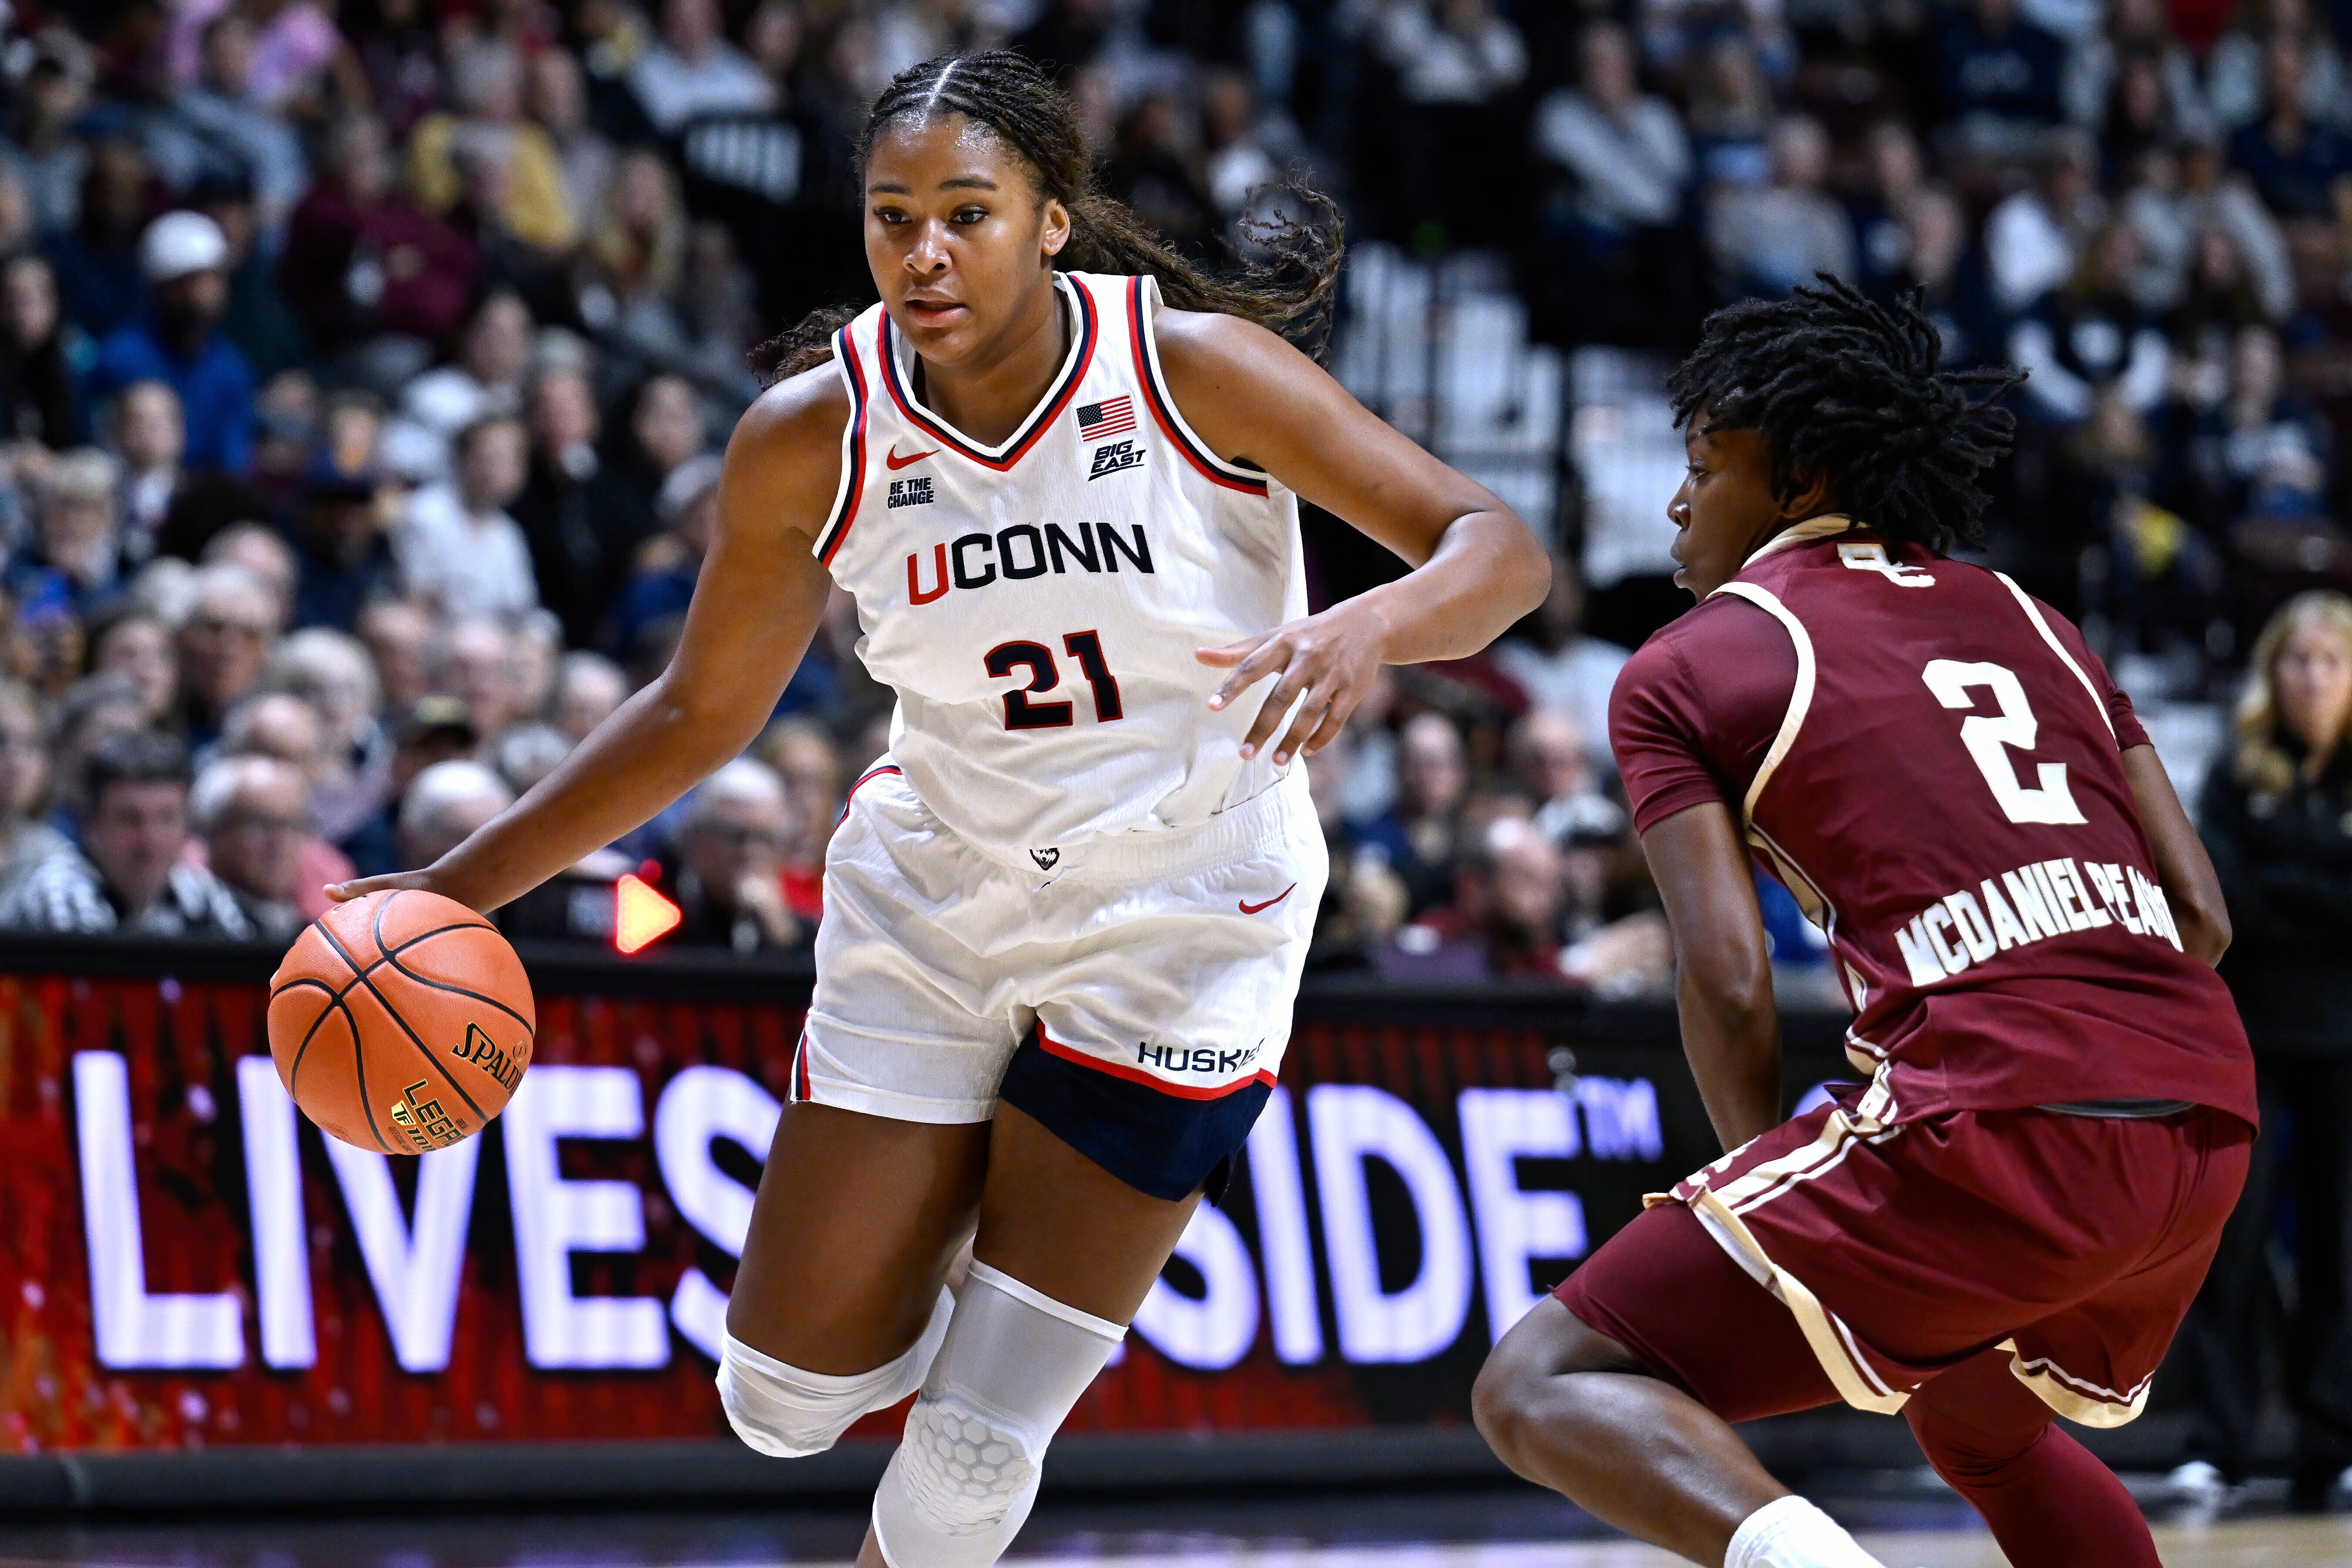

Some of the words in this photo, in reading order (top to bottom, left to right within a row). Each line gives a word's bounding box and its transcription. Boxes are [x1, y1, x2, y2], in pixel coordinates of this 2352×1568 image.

[1090, 449, 1146, 474] EAST
[1094, 439, 1133, 461] BIG
[887, 490, 934, 509] CHANGE
[890, 480, 904, 495] BE
[906, 477, 932, 493] THE
[907, 521, 1155, 605] UCONN
[983, 629, 1123, 730] 21
[1921, 659, 2089, 825] 2
[402, 1078, 467, 1148] LEGA
[72, 1050, 784, 1372] LIVES
